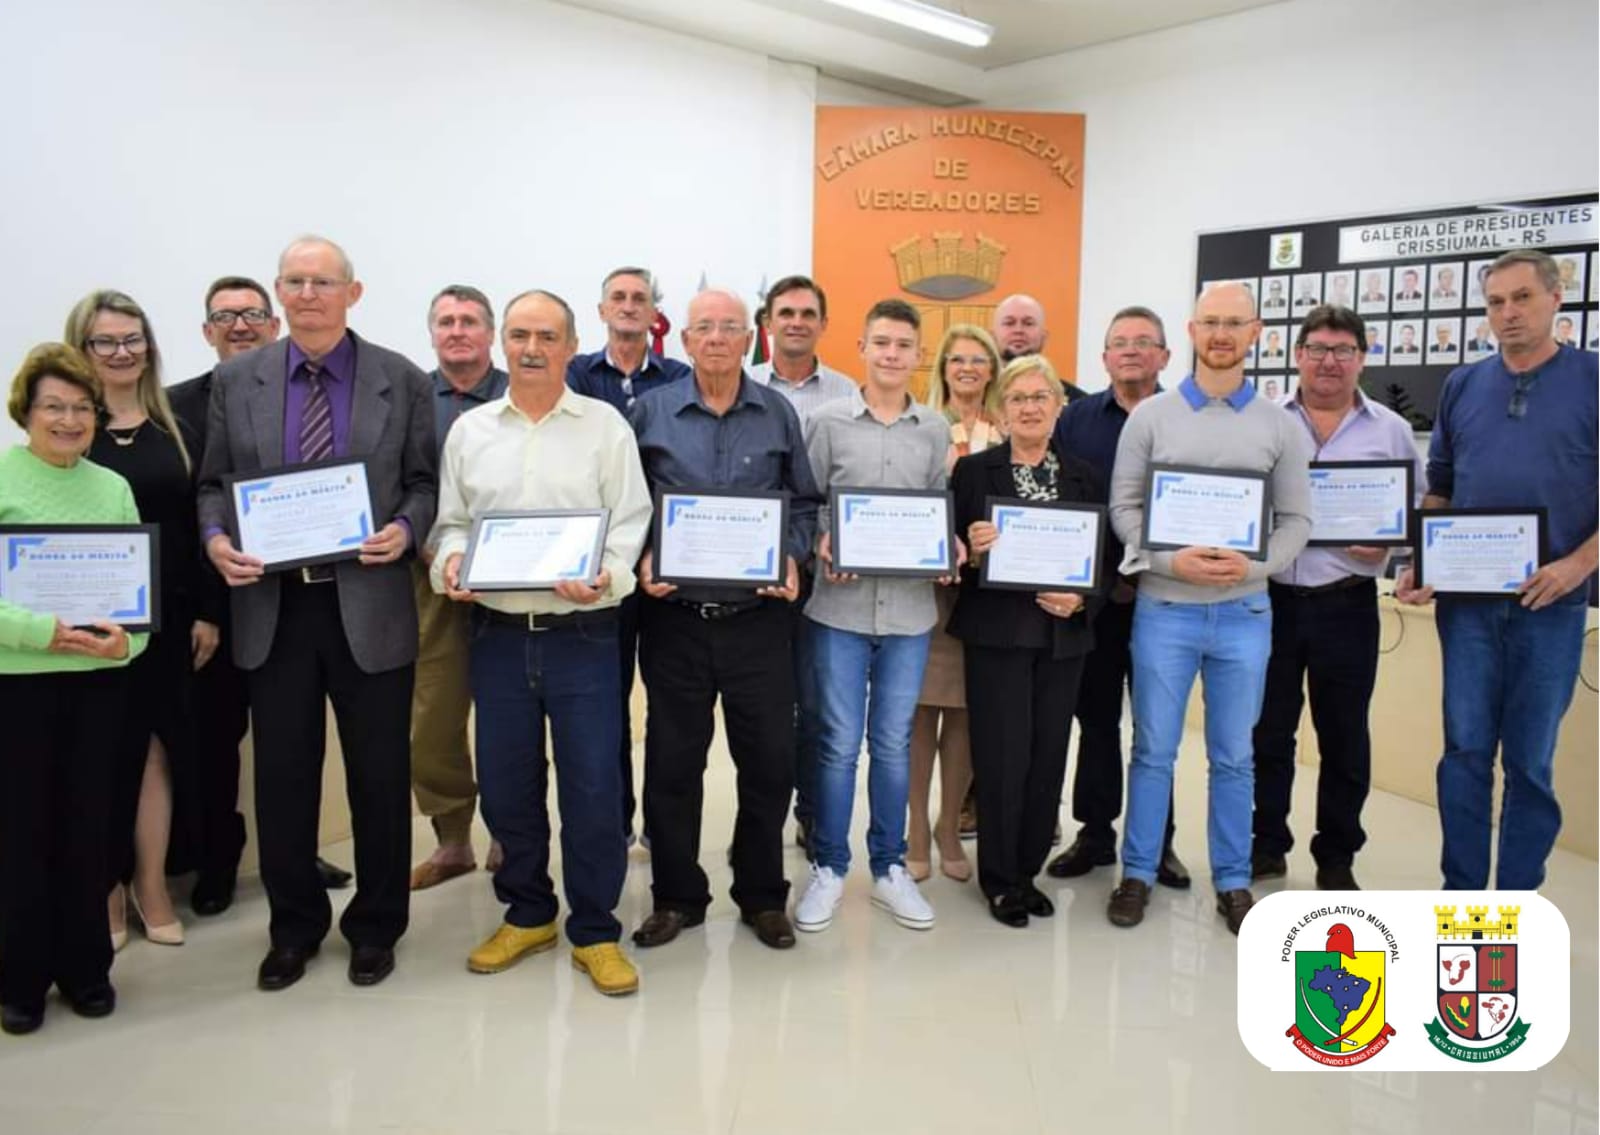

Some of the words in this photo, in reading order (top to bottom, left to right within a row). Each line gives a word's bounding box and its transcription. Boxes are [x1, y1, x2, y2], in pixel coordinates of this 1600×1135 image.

[818, 123, 918, 181] CÂMARA
[931, 115, 1078, 189] MUNICIPAL
[934, 157, 969, 179] DE
[856, 188, 1040, 214] VEREADORES
[1361, 224, 1430, 243] GALERIA
[1436, 221, 1458, 236] DE
[1464, 208, 1593, 232] PRESIDENTES
[1397, 239, 1501, 255] CRISSIUMAL
[1523, 229, 1547, 244] RS
